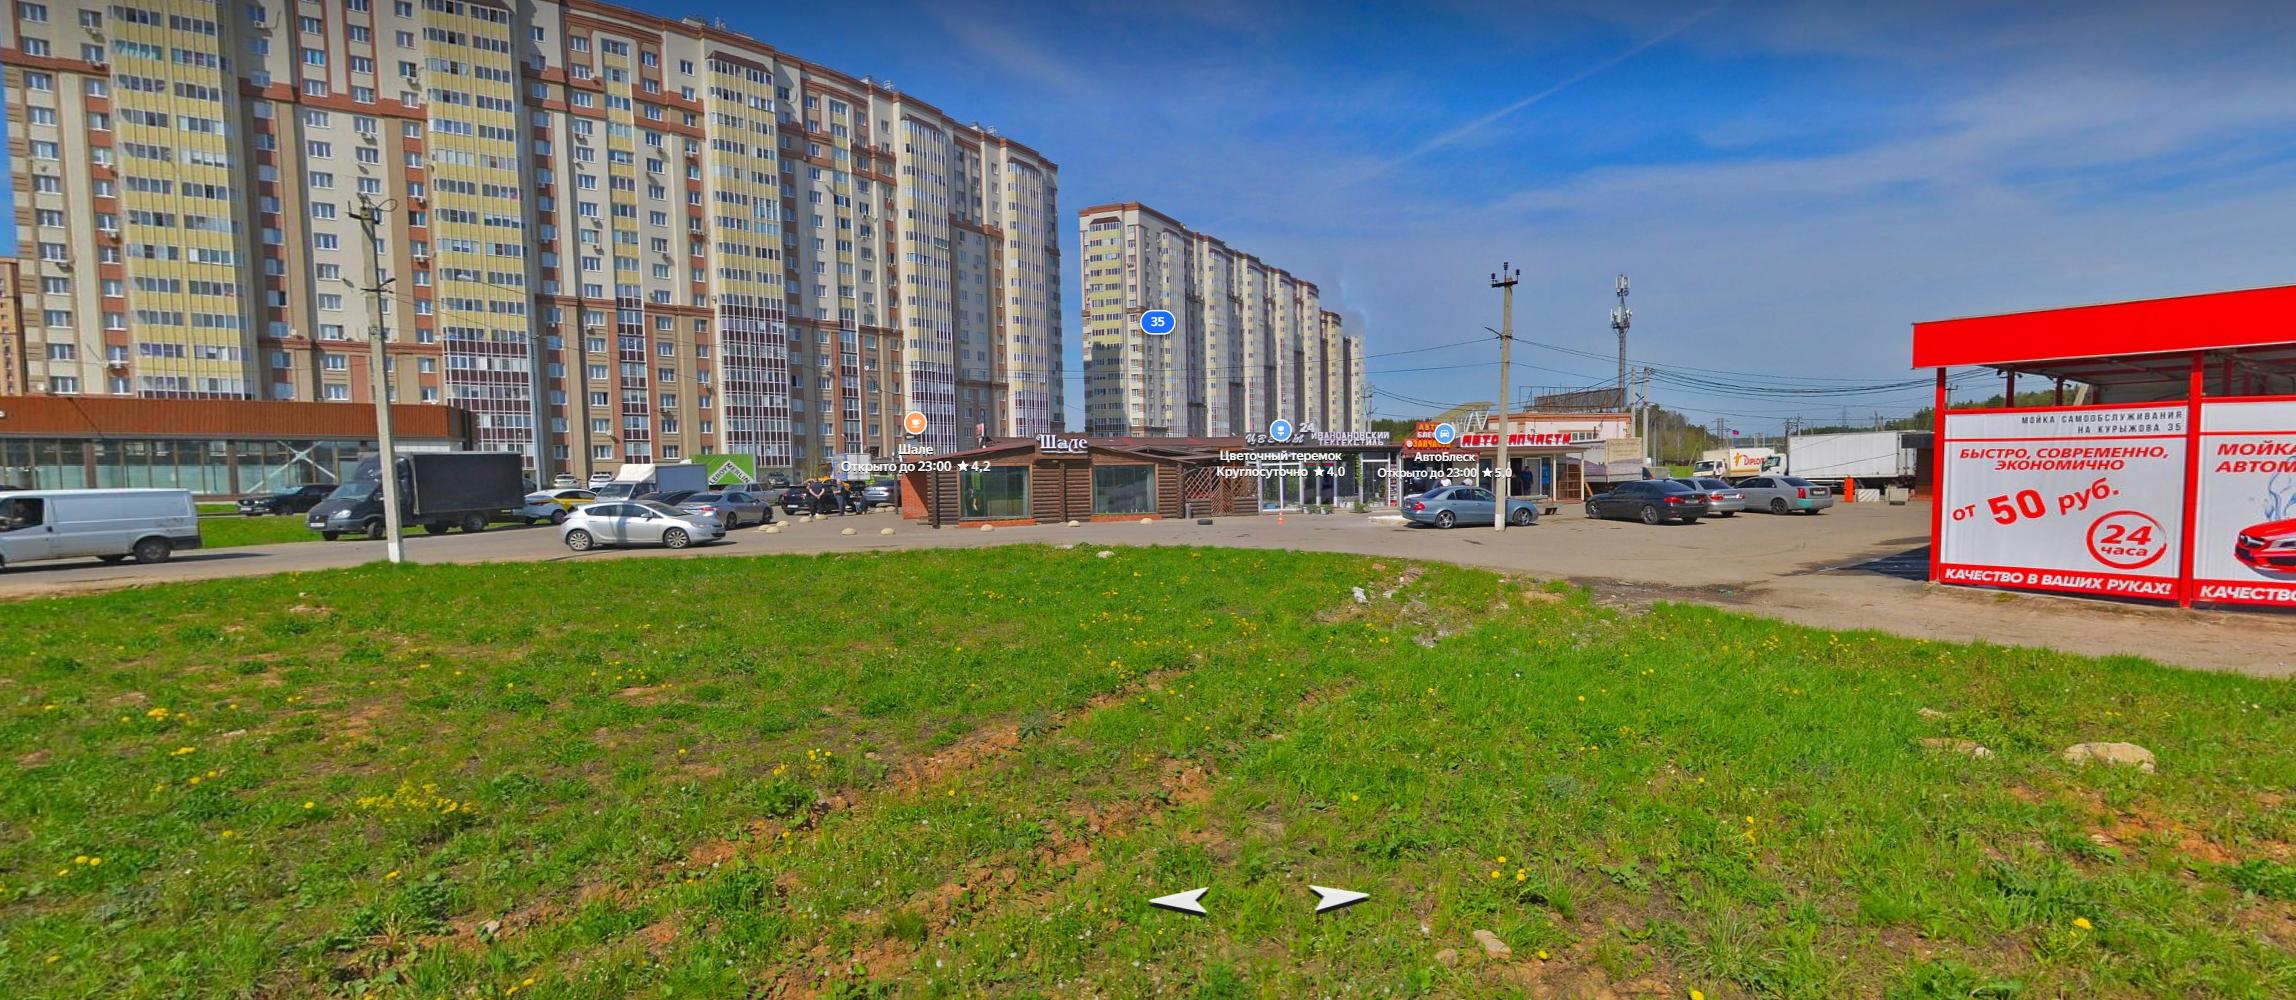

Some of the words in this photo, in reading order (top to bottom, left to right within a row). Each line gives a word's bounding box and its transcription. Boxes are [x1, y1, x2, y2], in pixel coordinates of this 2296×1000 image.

[2021, 414, 2056, 424] МОЙКА
[2061, 410, 2183, 424] САМООБСЛУЖИВАНИЯ
[2077, 425, 2091, 434] НА
[2098, 424, 2160, 433] КУРЫЖОВА
[2167, 422, 2182, 431] 35
[1036, 434, 1089, 453] Шале
[1412, 439, 1451, 448] ЗАПЧА
[1461, 432, 1571, 446] АВТОАПЧАСТИ
[1959, 448, 2031, 460] БЫСТРО,
[2036, 446, 2169, 460] СОВРЕМЕННО,
[1994, 459, 2126, 471] ЭКОНОМИЧНО
[1952, 504, 1976, 521] от
[1987, 489, 2046, 526] 50
[2058, 477, 2119, 515] руб.
[2100, 524, 2153, 545] 24
[2100, 546, 2149, 557] часа
[1944, 568, 2023, 584] КАЧЕСТВО
[2027, 573, 2038, 585] В
[2041, 574, 2104, 590] ВАШИХ
[2106, 578, 2173, 595] РУКАХ!
[2200, 584, 2296, 601] КАЧЕСТВ
